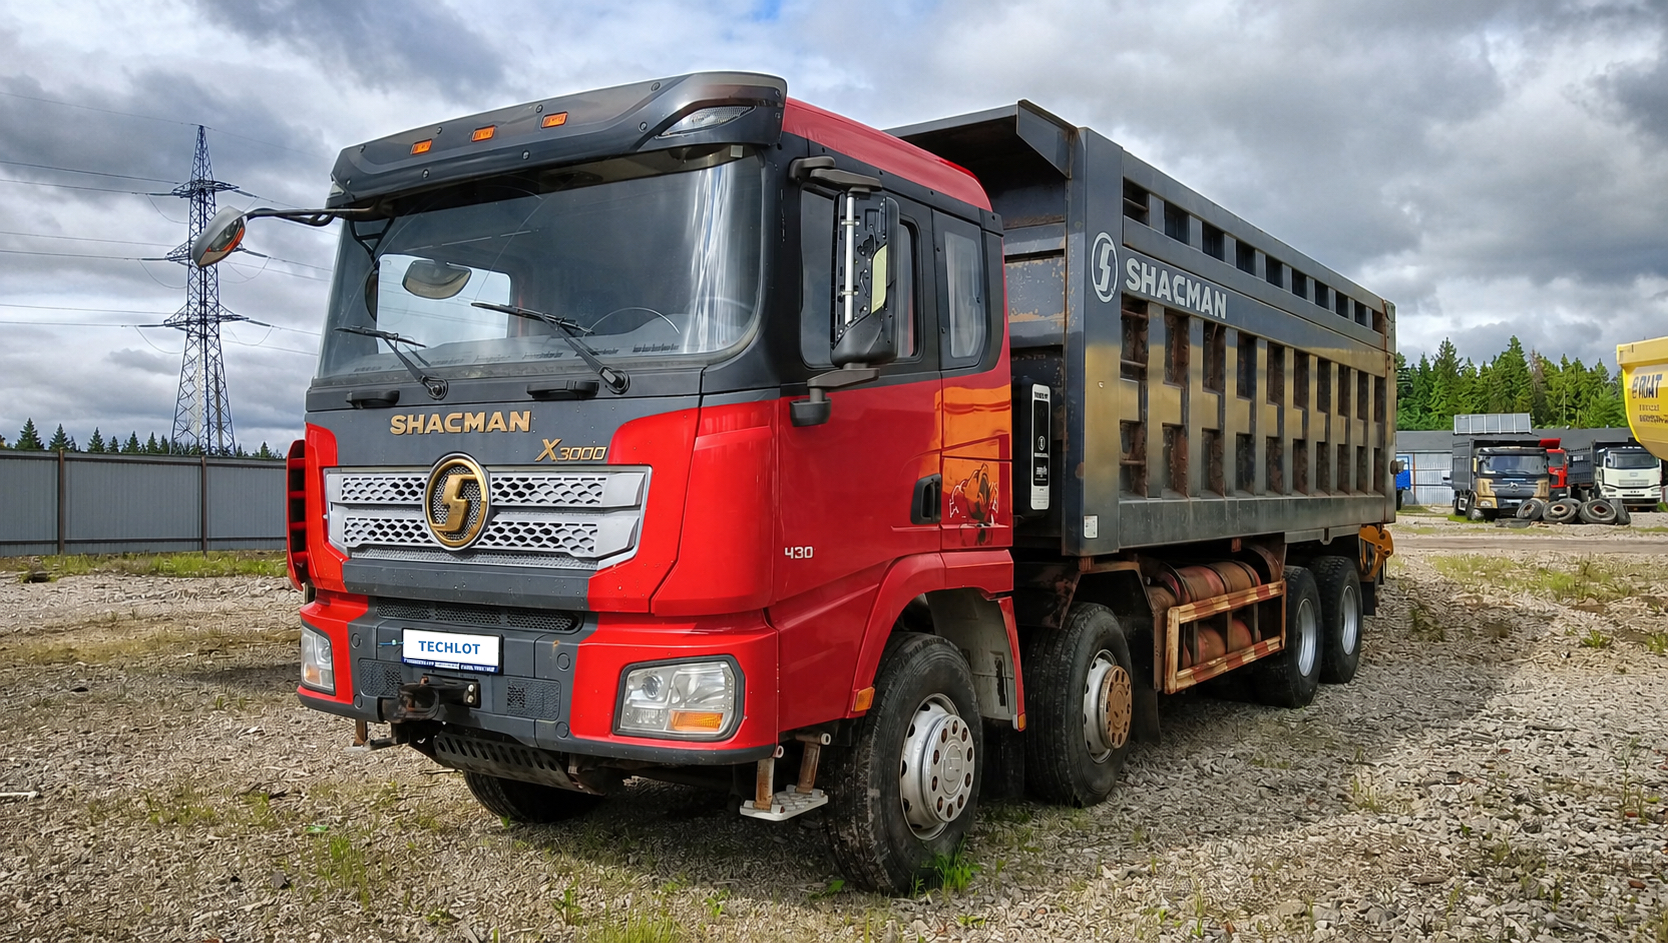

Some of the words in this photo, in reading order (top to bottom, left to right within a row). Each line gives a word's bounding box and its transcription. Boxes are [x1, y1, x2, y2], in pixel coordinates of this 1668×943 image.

[1125, 257, 1227, 320] SHACMAN
[389, 410, 531, 435] SHACMAN
[535, 438, 608, 462] X3000
[784, 546, 814, 559] 430
